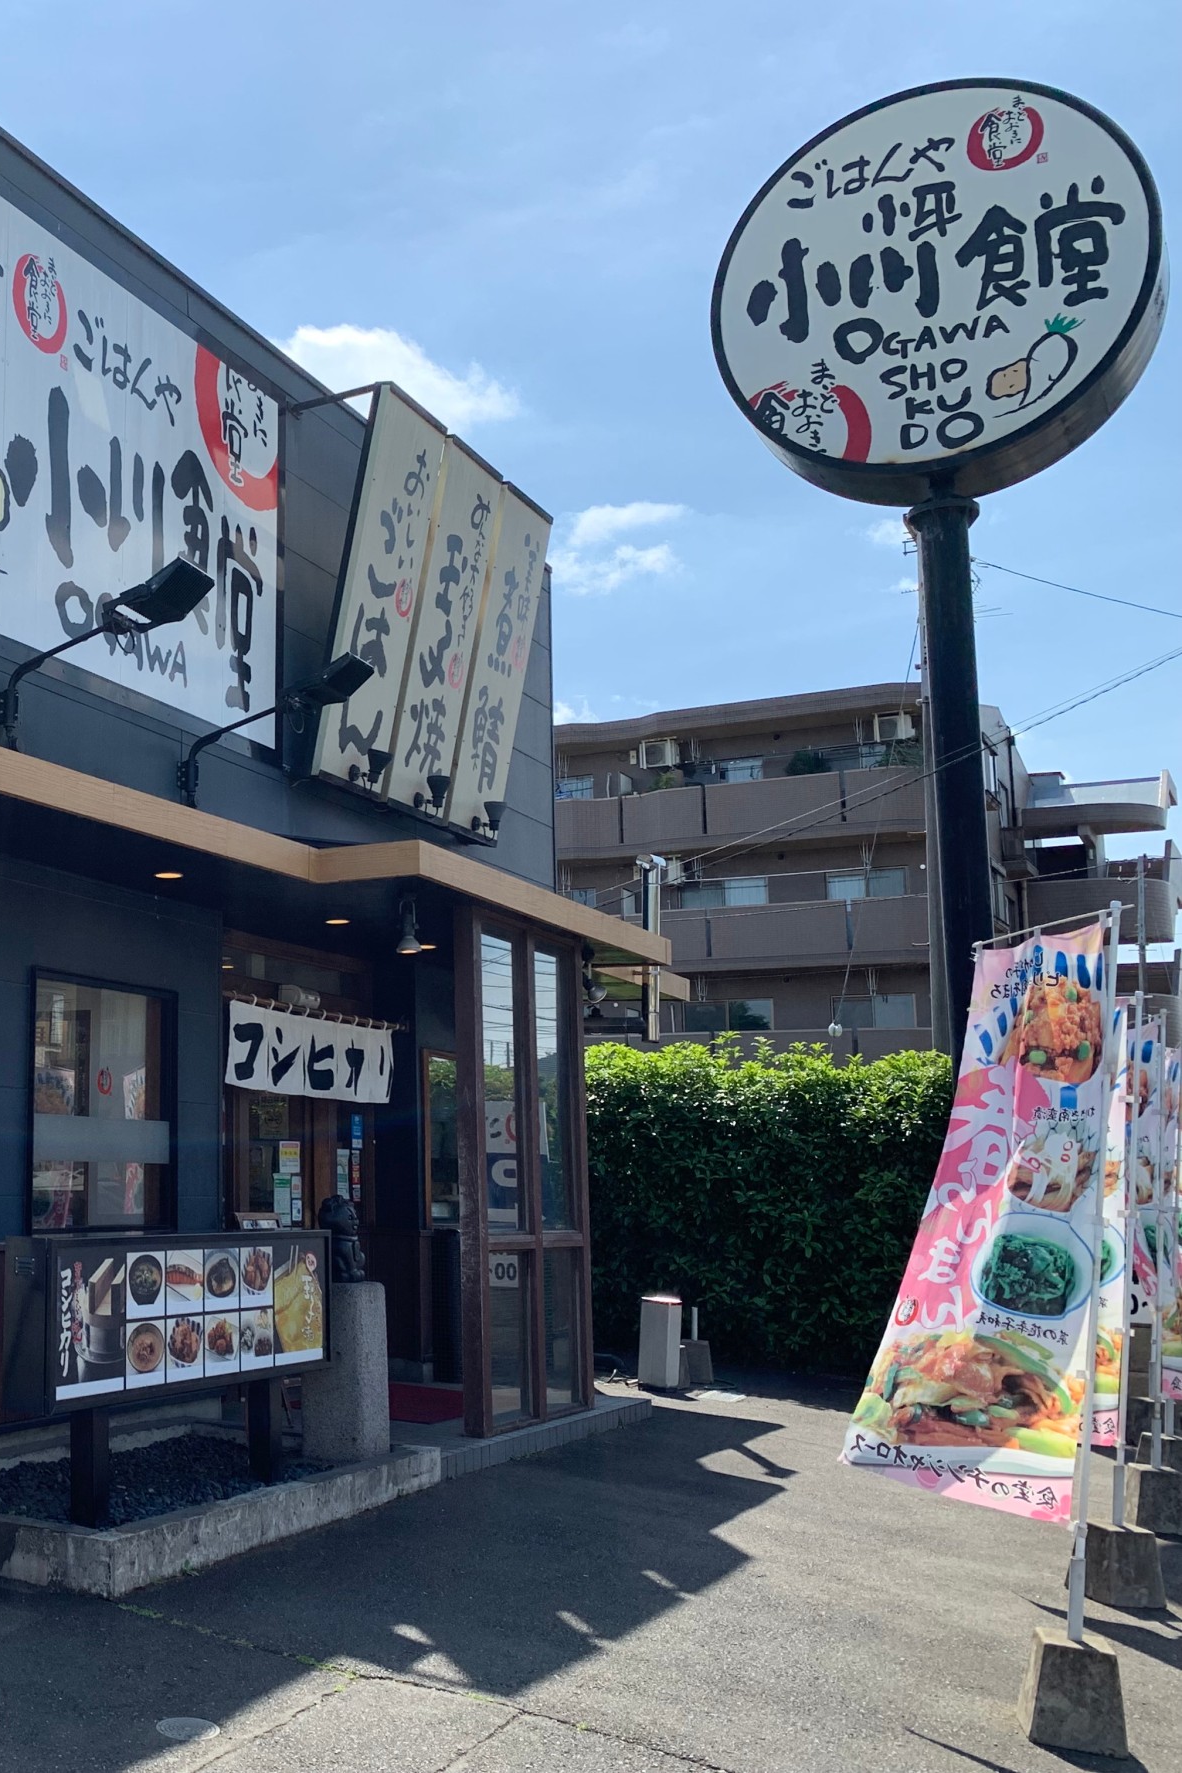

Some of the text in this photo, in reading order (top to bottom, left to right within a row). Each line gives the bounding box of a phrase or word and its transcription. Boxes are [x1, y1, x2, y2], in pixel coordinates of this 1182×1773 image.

[787, 137, 955, 209] ごはんや
[980, 113, 1007, 167] 食堂
[747, 176, 1126, 343] 小川食堂
[74, 309, 182, 426] ごはんや
[834, 314, 1009, 364] OGAWA
[880, 358, 967, 400] SHO
[906, 386, 971, 419] KU
[900, 411, 984, 450] DO
[401, 449, 430, 569] おいしい
[338, 497, 404, 756] ごはん
[405, 534, 468, 777] 玉子焼
[233, 1022, 393, 1098] コシヒカリ
[59, 1268, 73, 1377] コシヒカリ
